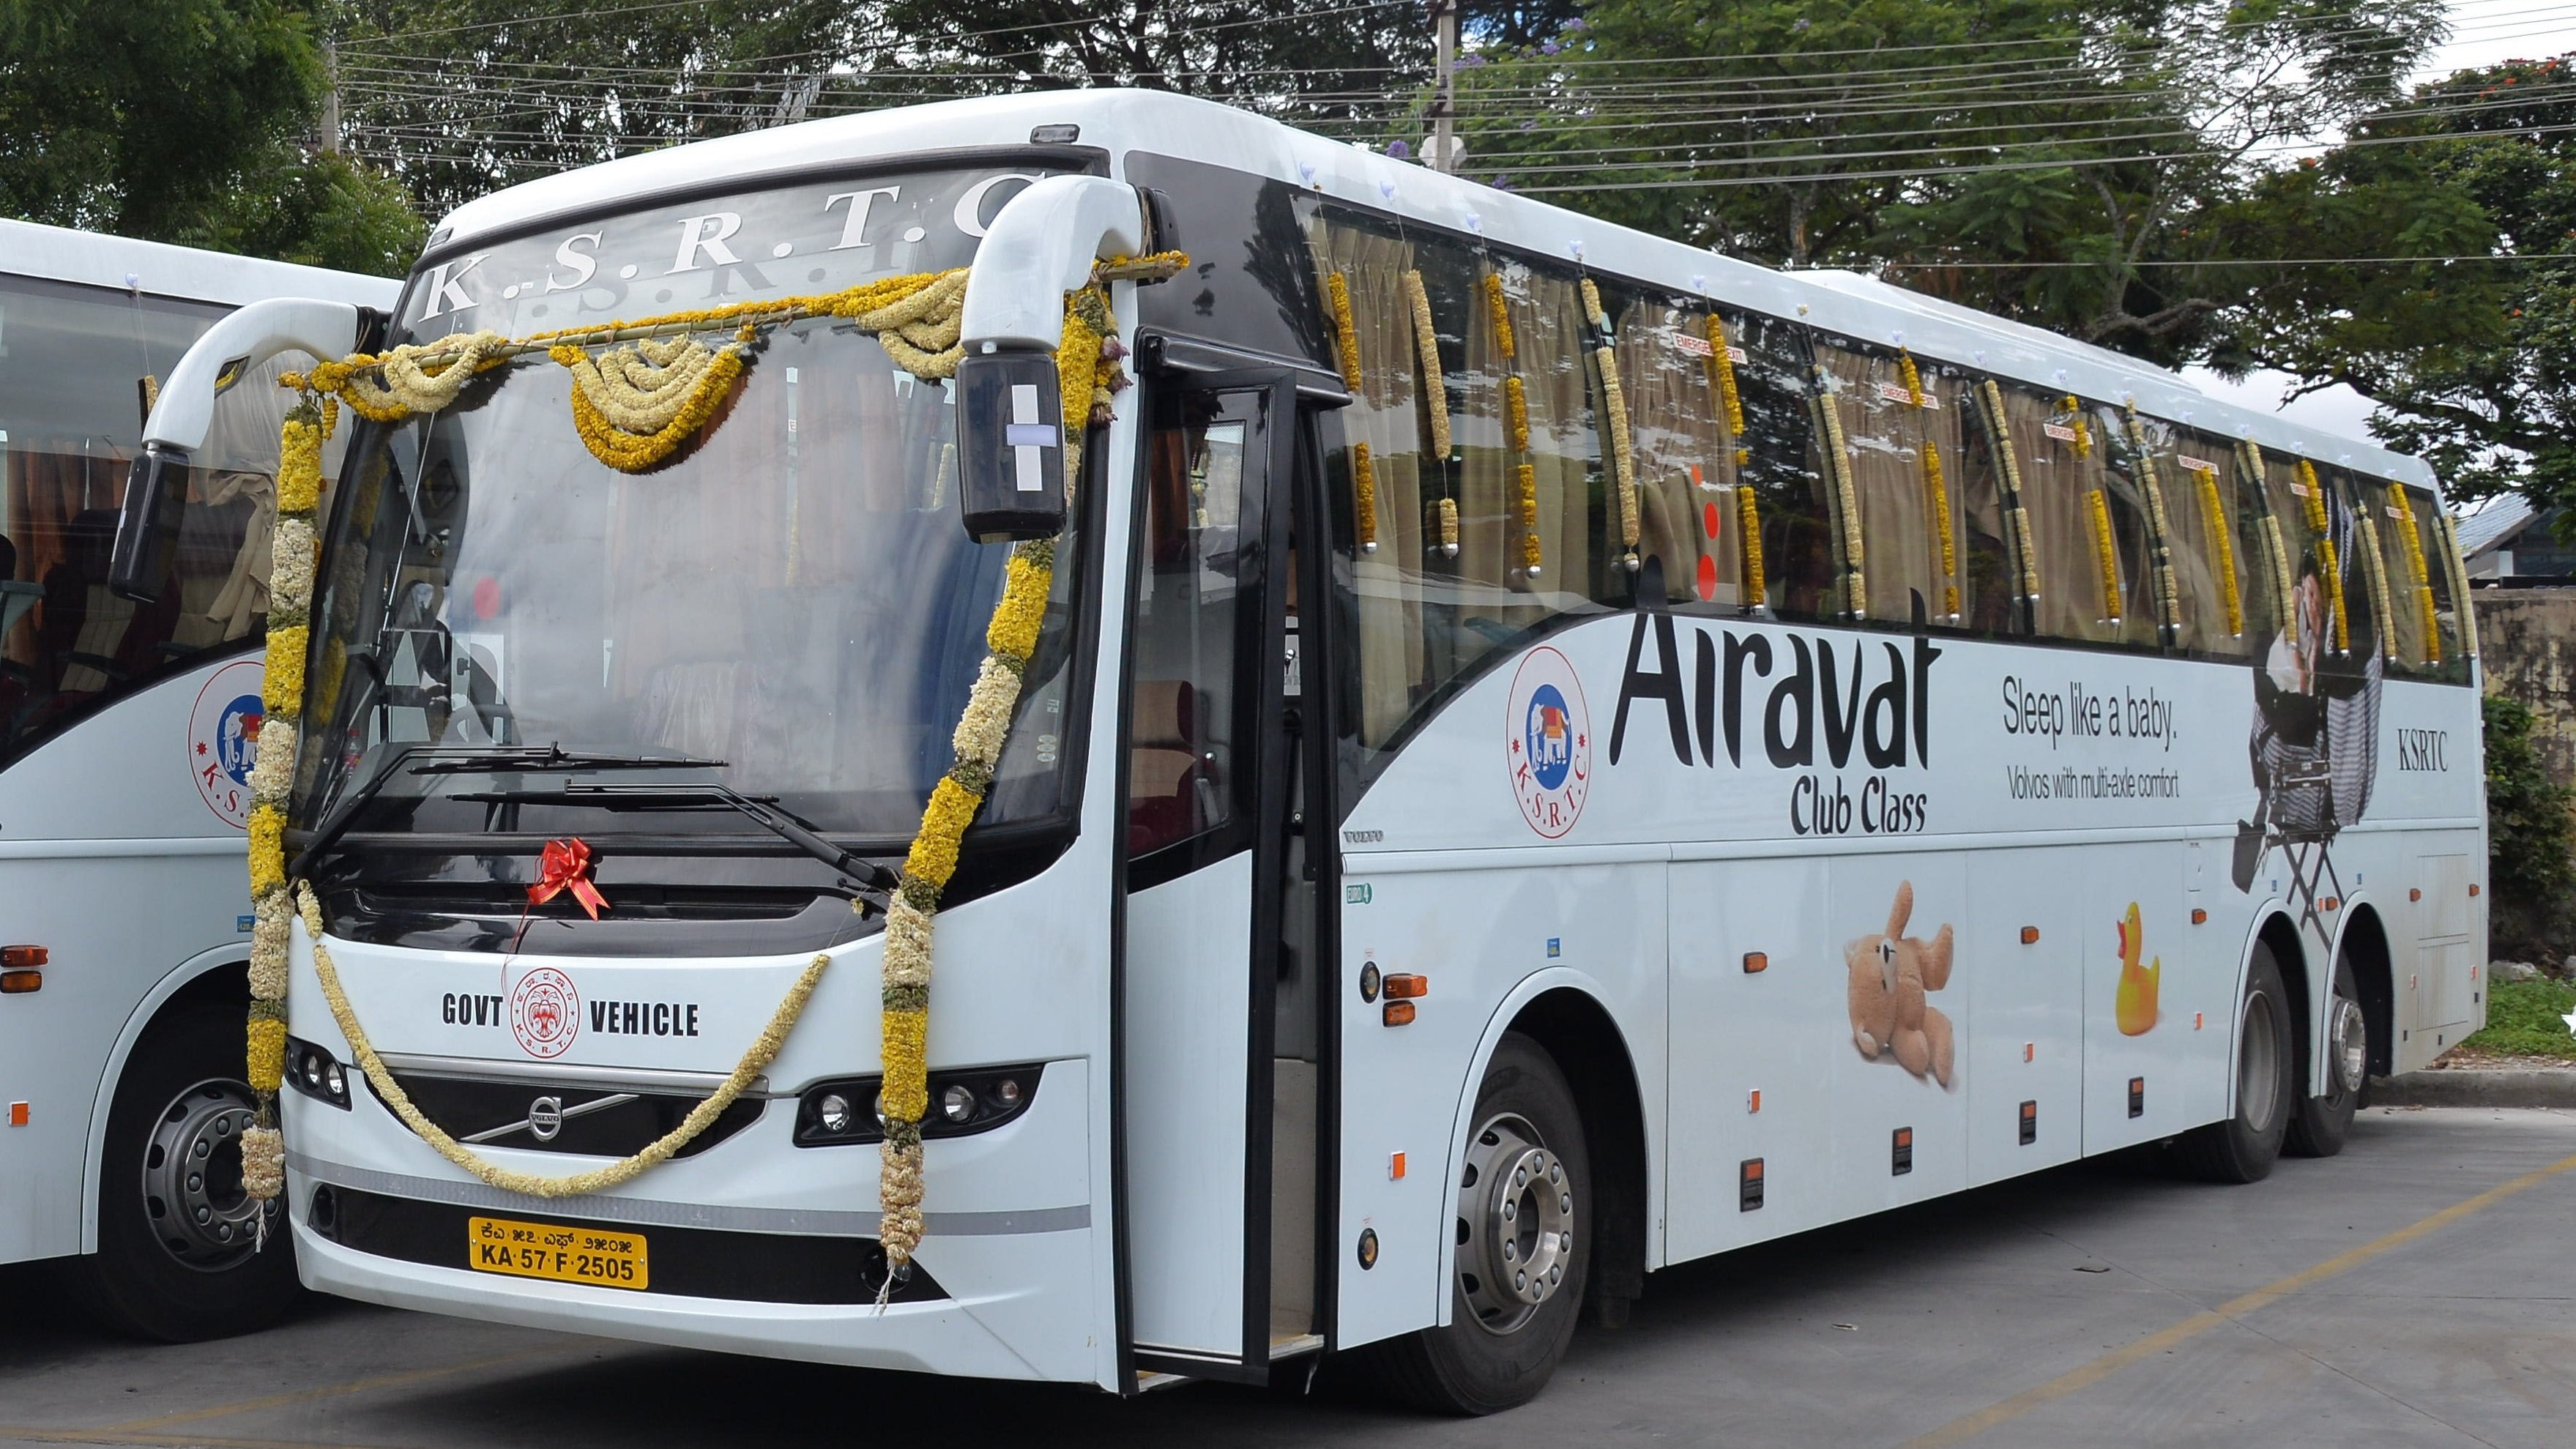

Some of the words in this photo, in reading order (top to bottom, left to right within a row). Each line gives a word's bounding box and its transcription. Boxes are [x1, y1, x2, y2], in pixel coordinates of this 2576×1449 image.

[1675, 335, 1711, 354] EMERGE
[1882, 387, 1912, 402] EMERGE
[1609, 554, 1942, 770] Airavat
[2003, 675, 2063, 750] Sleep
[2070, 681, 2102, 737] like
[2109, 696, 2121, 737] a
[2126, 685, 2177, 753] baby.
[2397, 728, 2449, 773] KSRTC
[2007, 765, 2050, 799] Volvos
[2052, 766, 2078, 798] with
[2081, 766, 2135, 798] multi-axle
[2138, 767, 2179, 798] comfort
[1790, 774, 1852, 835] Club
[1861, 775, 1928, 833] Class
[1343, 830, 1385, 843] VOLVO
[442, 993, 503, 1027] GOVT
[590, 1000, 699, 1037] VEHICLE
[531, 1113, 559, 1122] VOLVO
[577, 1255, 634, 1281] 2505
